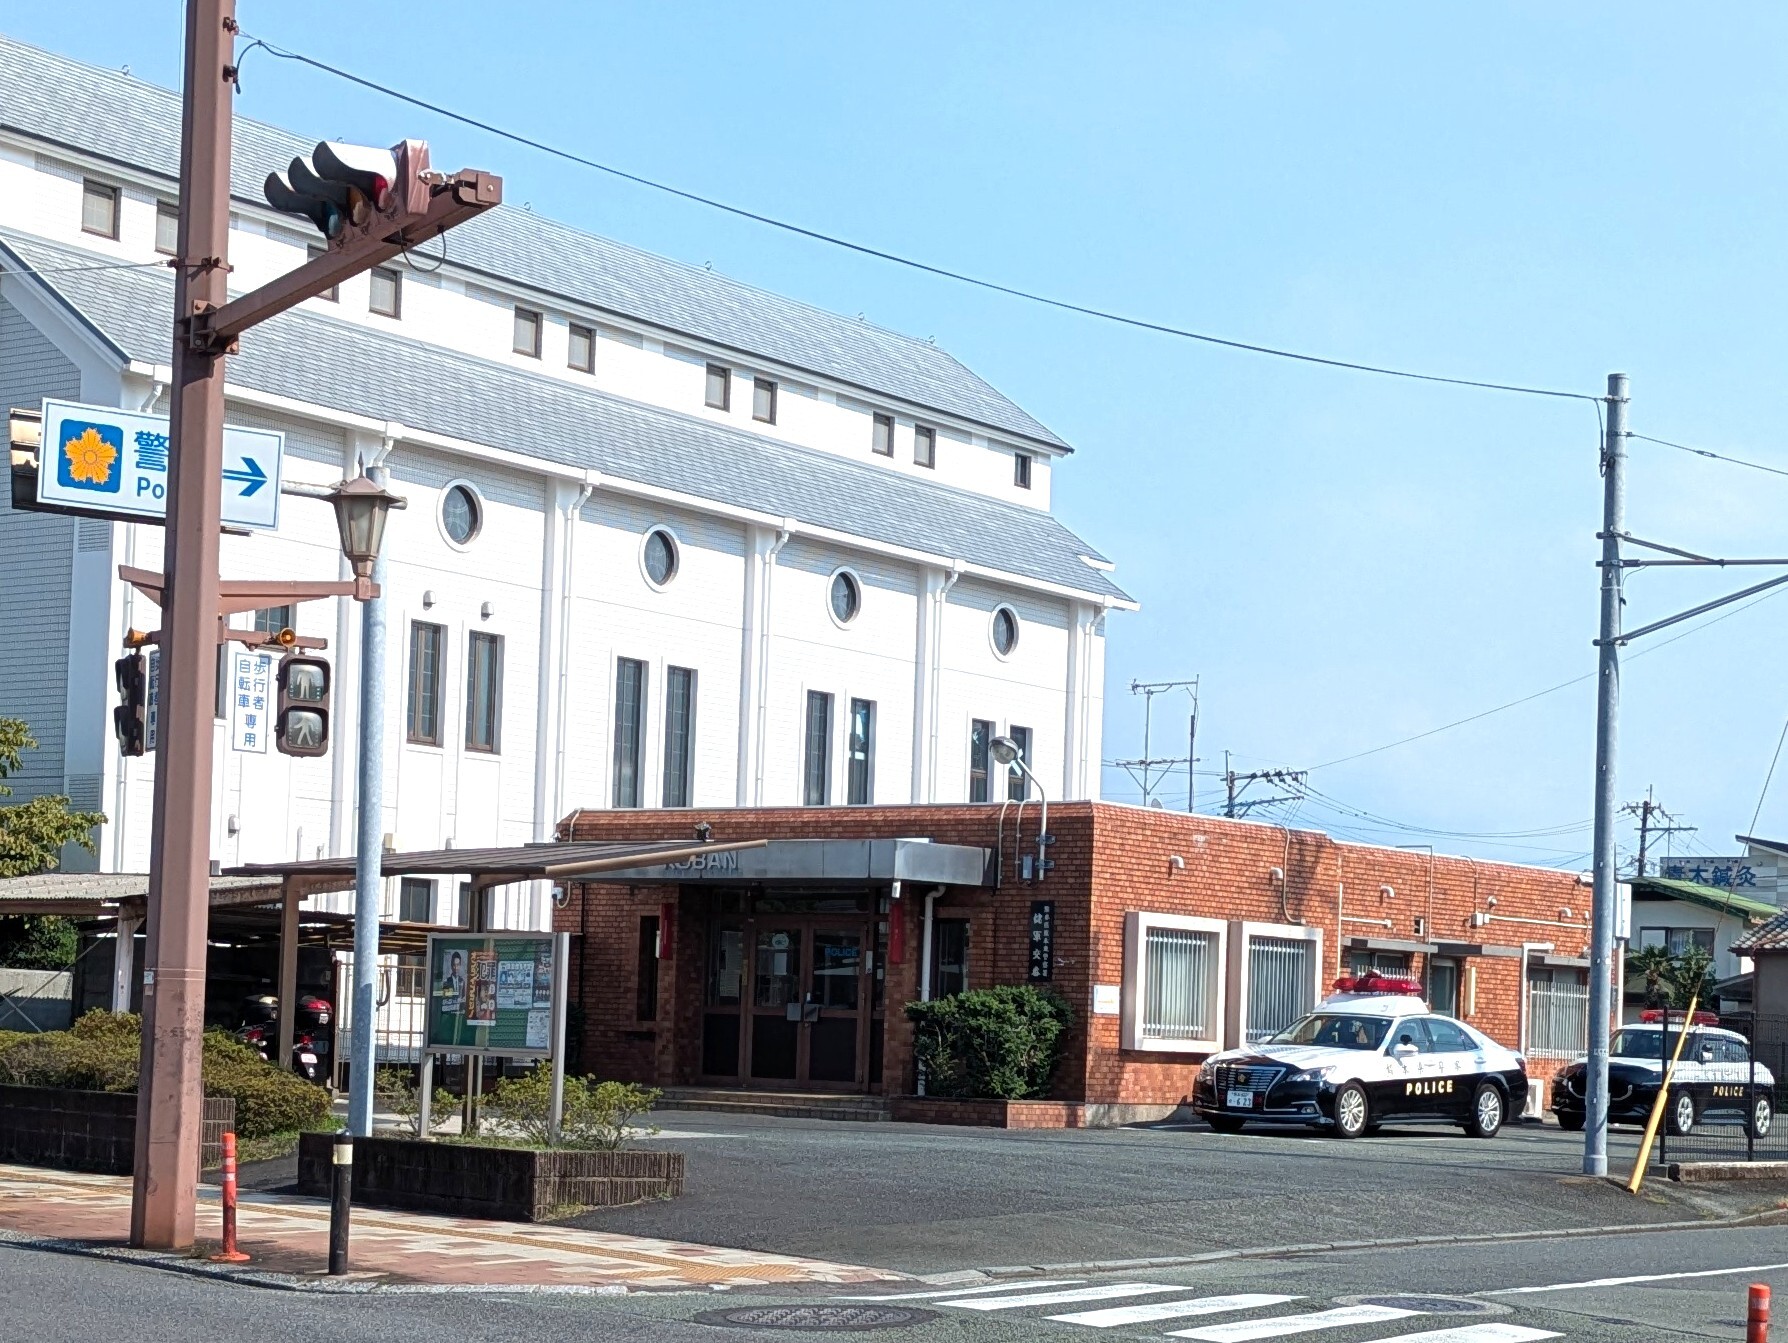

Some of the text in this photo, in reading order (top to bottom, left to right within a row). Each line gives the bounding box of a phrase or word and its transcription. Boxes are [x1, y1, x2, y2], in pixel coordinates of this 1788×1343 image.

[238, 659, 251, 708] 自転車
[253, 660, 267, 710] 歩行者
[244, 713, 257, 748] 専用
[1406, 1080, 1453, 1096] POLICE
[1712, 1085, 1744, 1097] POLICE
